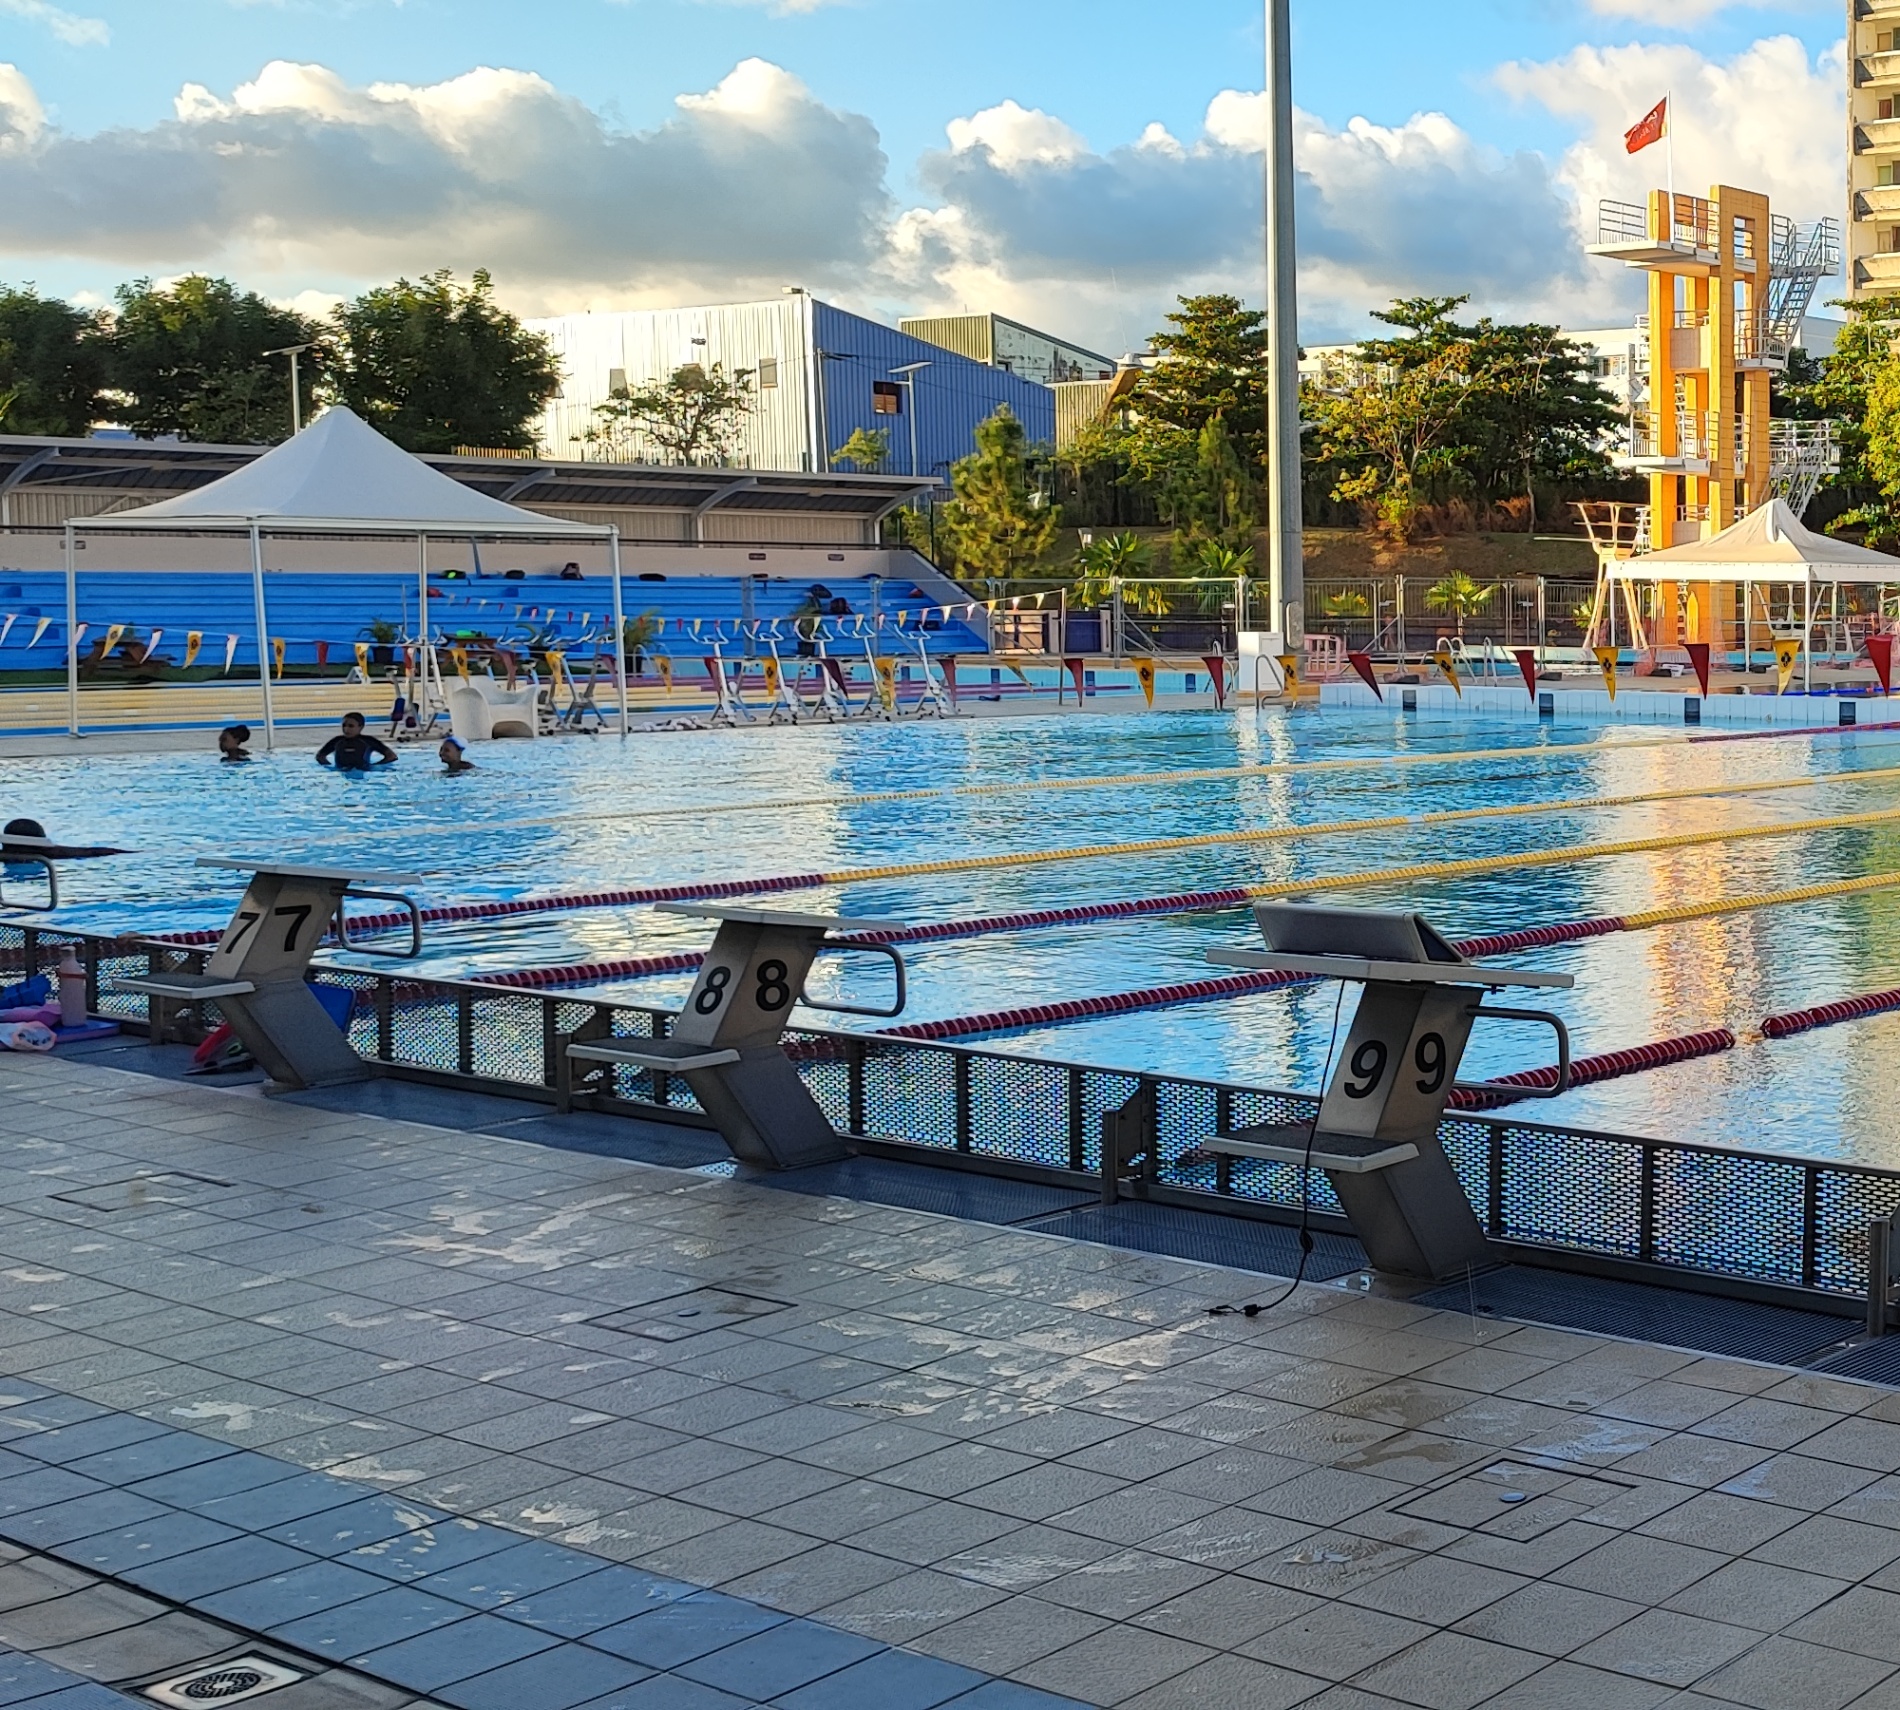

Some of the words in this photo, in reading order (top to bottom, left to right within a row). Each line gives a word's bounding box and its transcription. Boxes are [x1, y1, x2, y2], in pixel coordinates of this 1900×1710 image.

[226, 912, 260, 954] 7
[275, 905, 311, 952] 7
[695, 966, 731, 1015] 8
[756, 959, 790, 1011] 8
[1344, 1040, 1388, 1098] 9
[1415, 1032, 1446, 1094] 9
